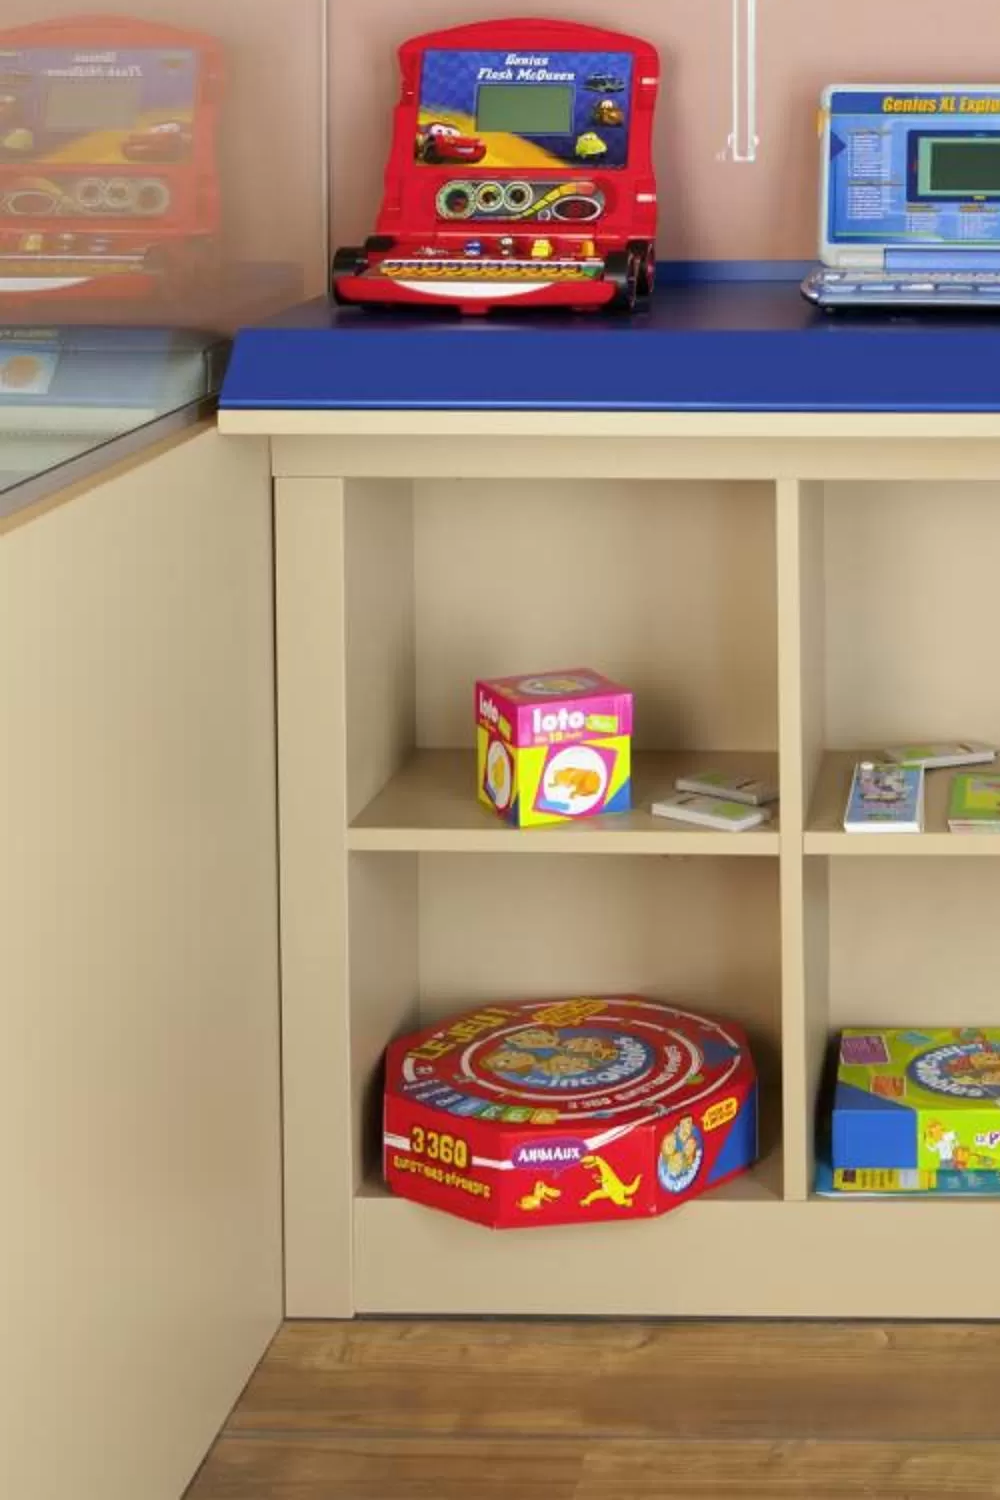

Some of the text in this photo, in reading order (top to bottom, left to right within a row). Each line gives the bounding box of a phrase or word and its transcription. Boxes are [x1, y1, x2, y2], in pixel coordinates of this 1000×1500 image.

[505, 53, 549, 66] Genius
[478, 67, 513, 80] Flash
[883, 96, 937, 113] Genius
[939, 96, 956, 113] XL
[532, 707, 585, 734] loto
[518, 1147, 580, 1163] ANIMAUX
